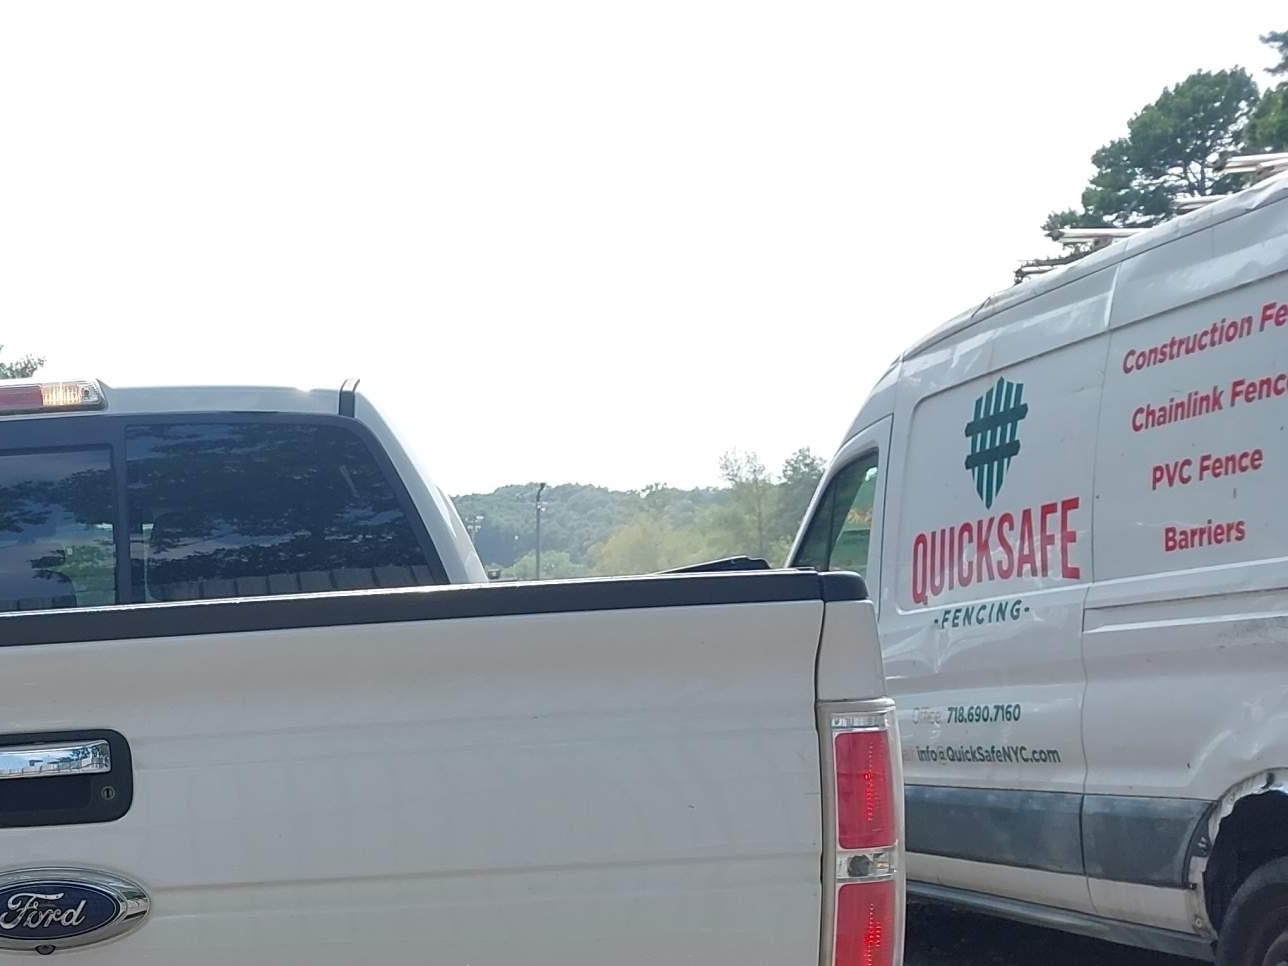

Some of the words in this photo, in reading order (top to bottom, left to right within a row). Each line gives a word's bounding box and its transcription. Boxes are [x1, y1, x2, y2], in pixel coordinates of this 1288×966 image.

[1123, 316, 1253, 374] Construction
[1132, 385, 1224, 432] Chainlink
[1230, 373, 1288, 407] Fenc
[1152, 458, 1193, 491] PVC
[1199, 448, 1264, 481] Fence
[912, 496, 1081, 606] QUICKSAFE
[1164, 519, 1246, 552] Barriers
[946, 703, 1021, 724] 718.690.7160
[915, 745, 1062, 765] info@QuickSafeNYC.com
[0, 892, 87, 929] Ford
